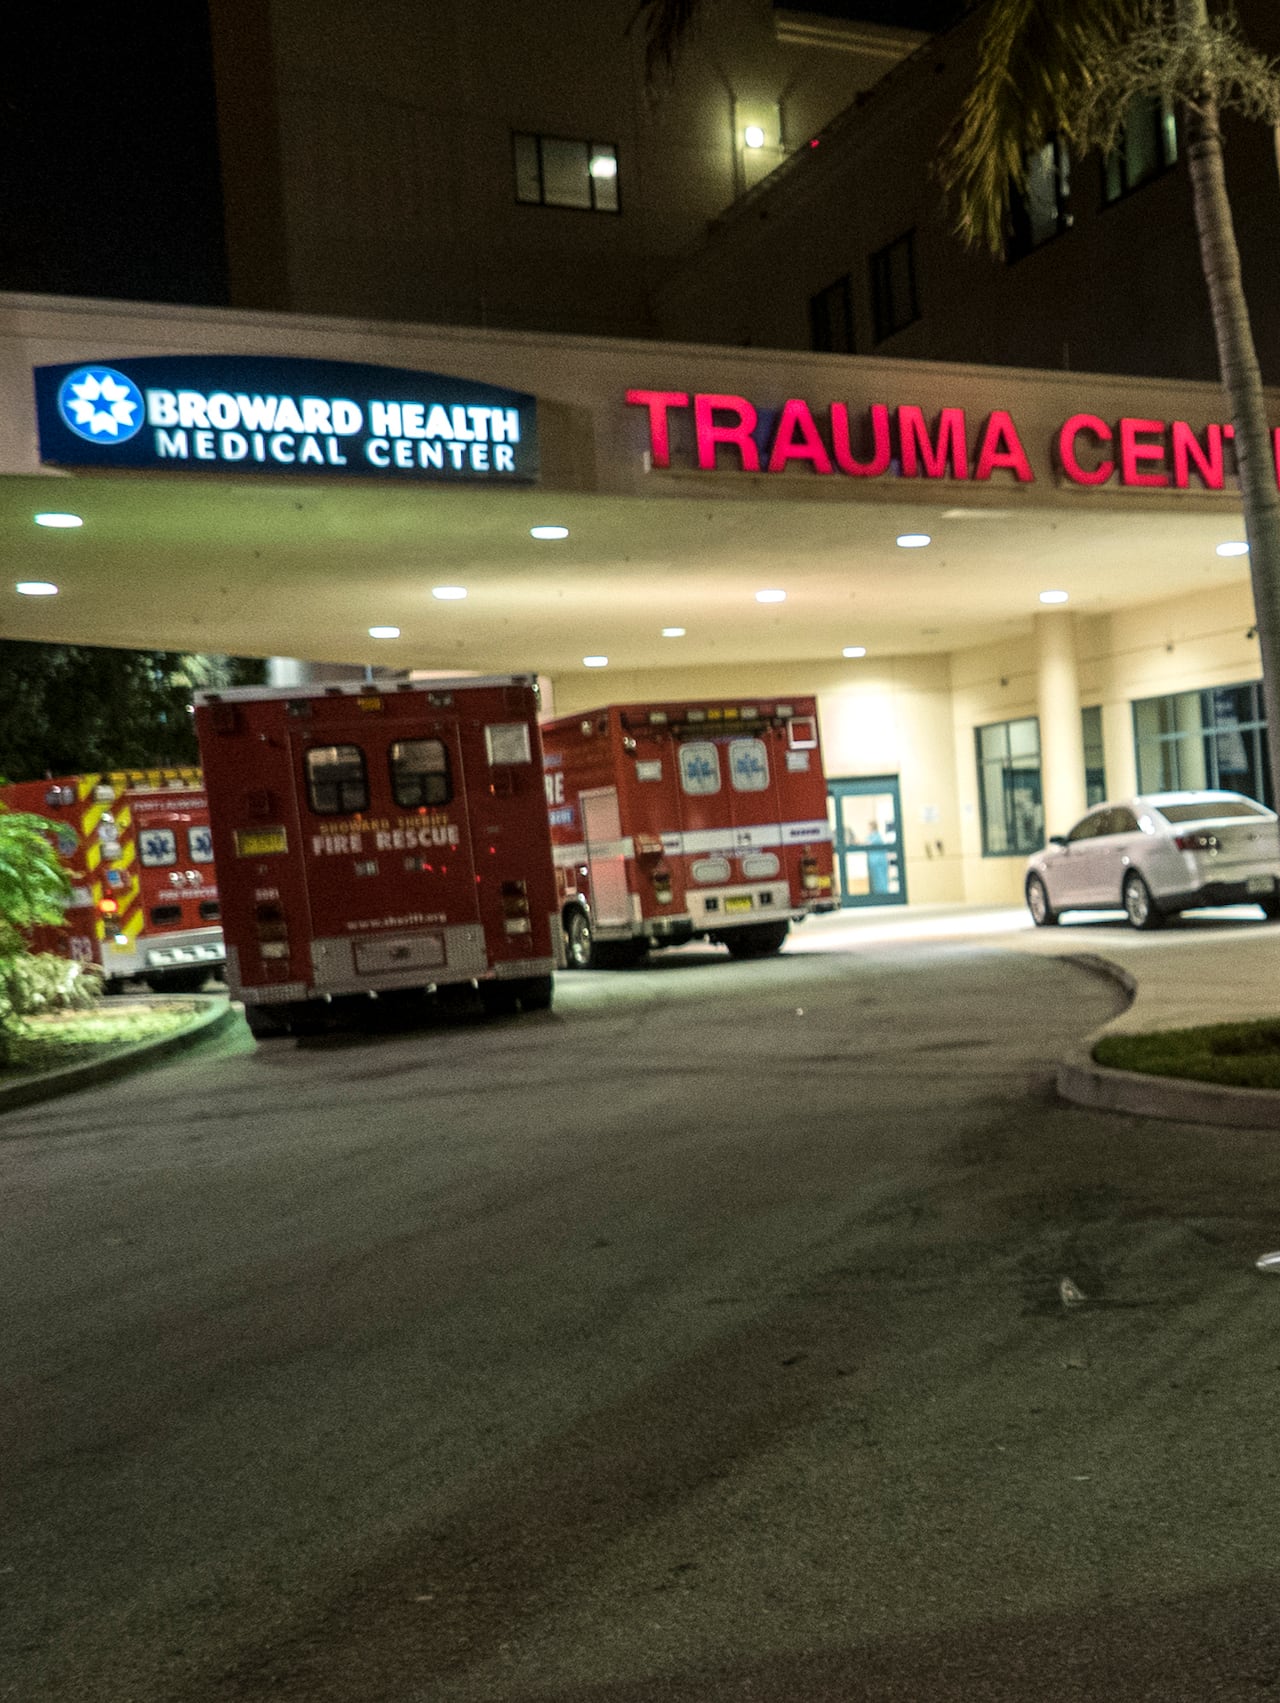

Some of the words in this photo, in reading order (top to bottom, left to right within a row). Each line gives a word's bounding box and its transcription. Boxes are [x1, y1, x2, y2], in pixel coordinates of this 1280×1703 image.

[147, 389, 363, 437] BROWARD
[370, 401, 520, 443] HEALTH
[625, 389, 1035, 483] TRAUMA
[154, 429, 348, 465] MEDICAL
[365, 437, 516, 472] CENTER
[313, 833, 362, 856] FIRE
[377, 825, 460, 850] RESCUE
